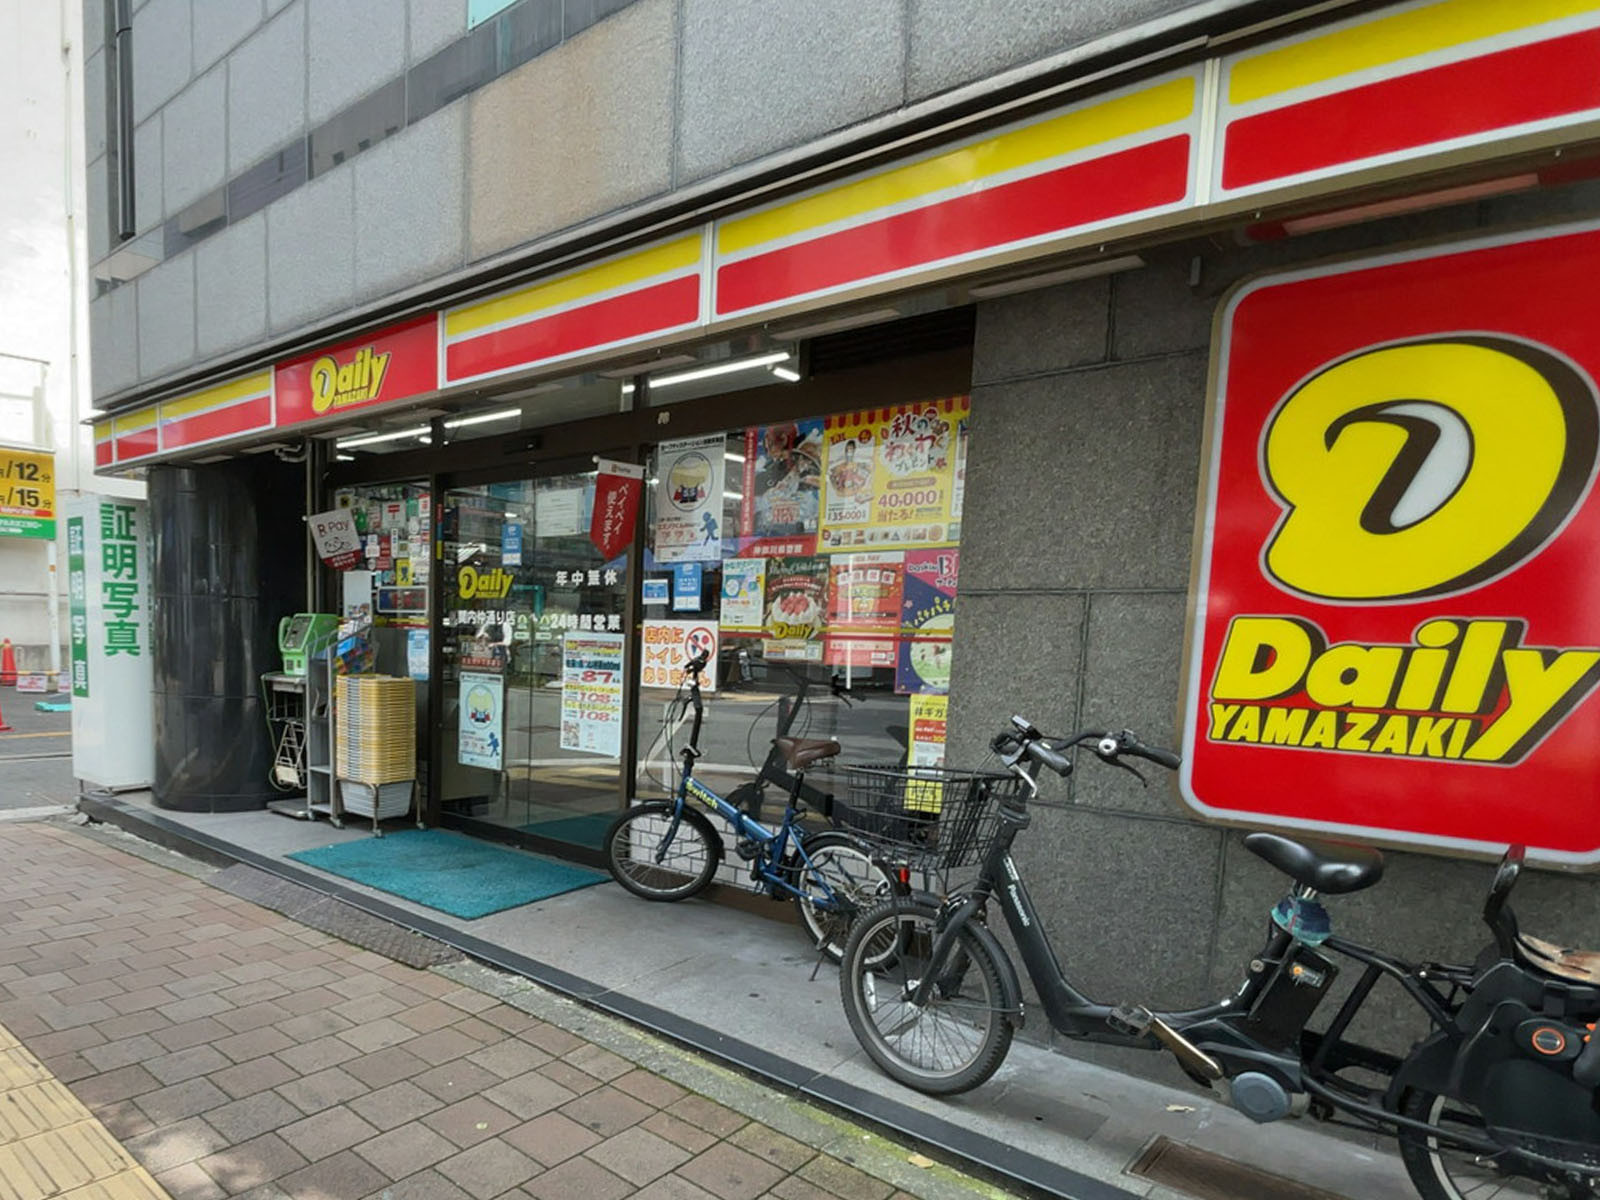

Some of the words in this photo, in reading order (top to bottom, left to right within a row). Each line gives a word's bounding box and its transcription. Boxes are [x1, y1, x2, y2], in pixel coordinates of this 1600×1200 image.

[311, 345, 391, 413] Daily
[99, 502, 141, 657] 証明写真
[458, 566, 514, 600] Daily
[555, 569, 617, 586] 年中無休
[550, 613, 621, 631] 24時間営業
[771, 622, 815, 640] Daily
[644, 626, 684, 645] 店内に
[645, 646, 683, 665] トイレ
[1211, 614, 1600, 764] Daily
[1210, 702, 1473, 759] YAMAZAKI
